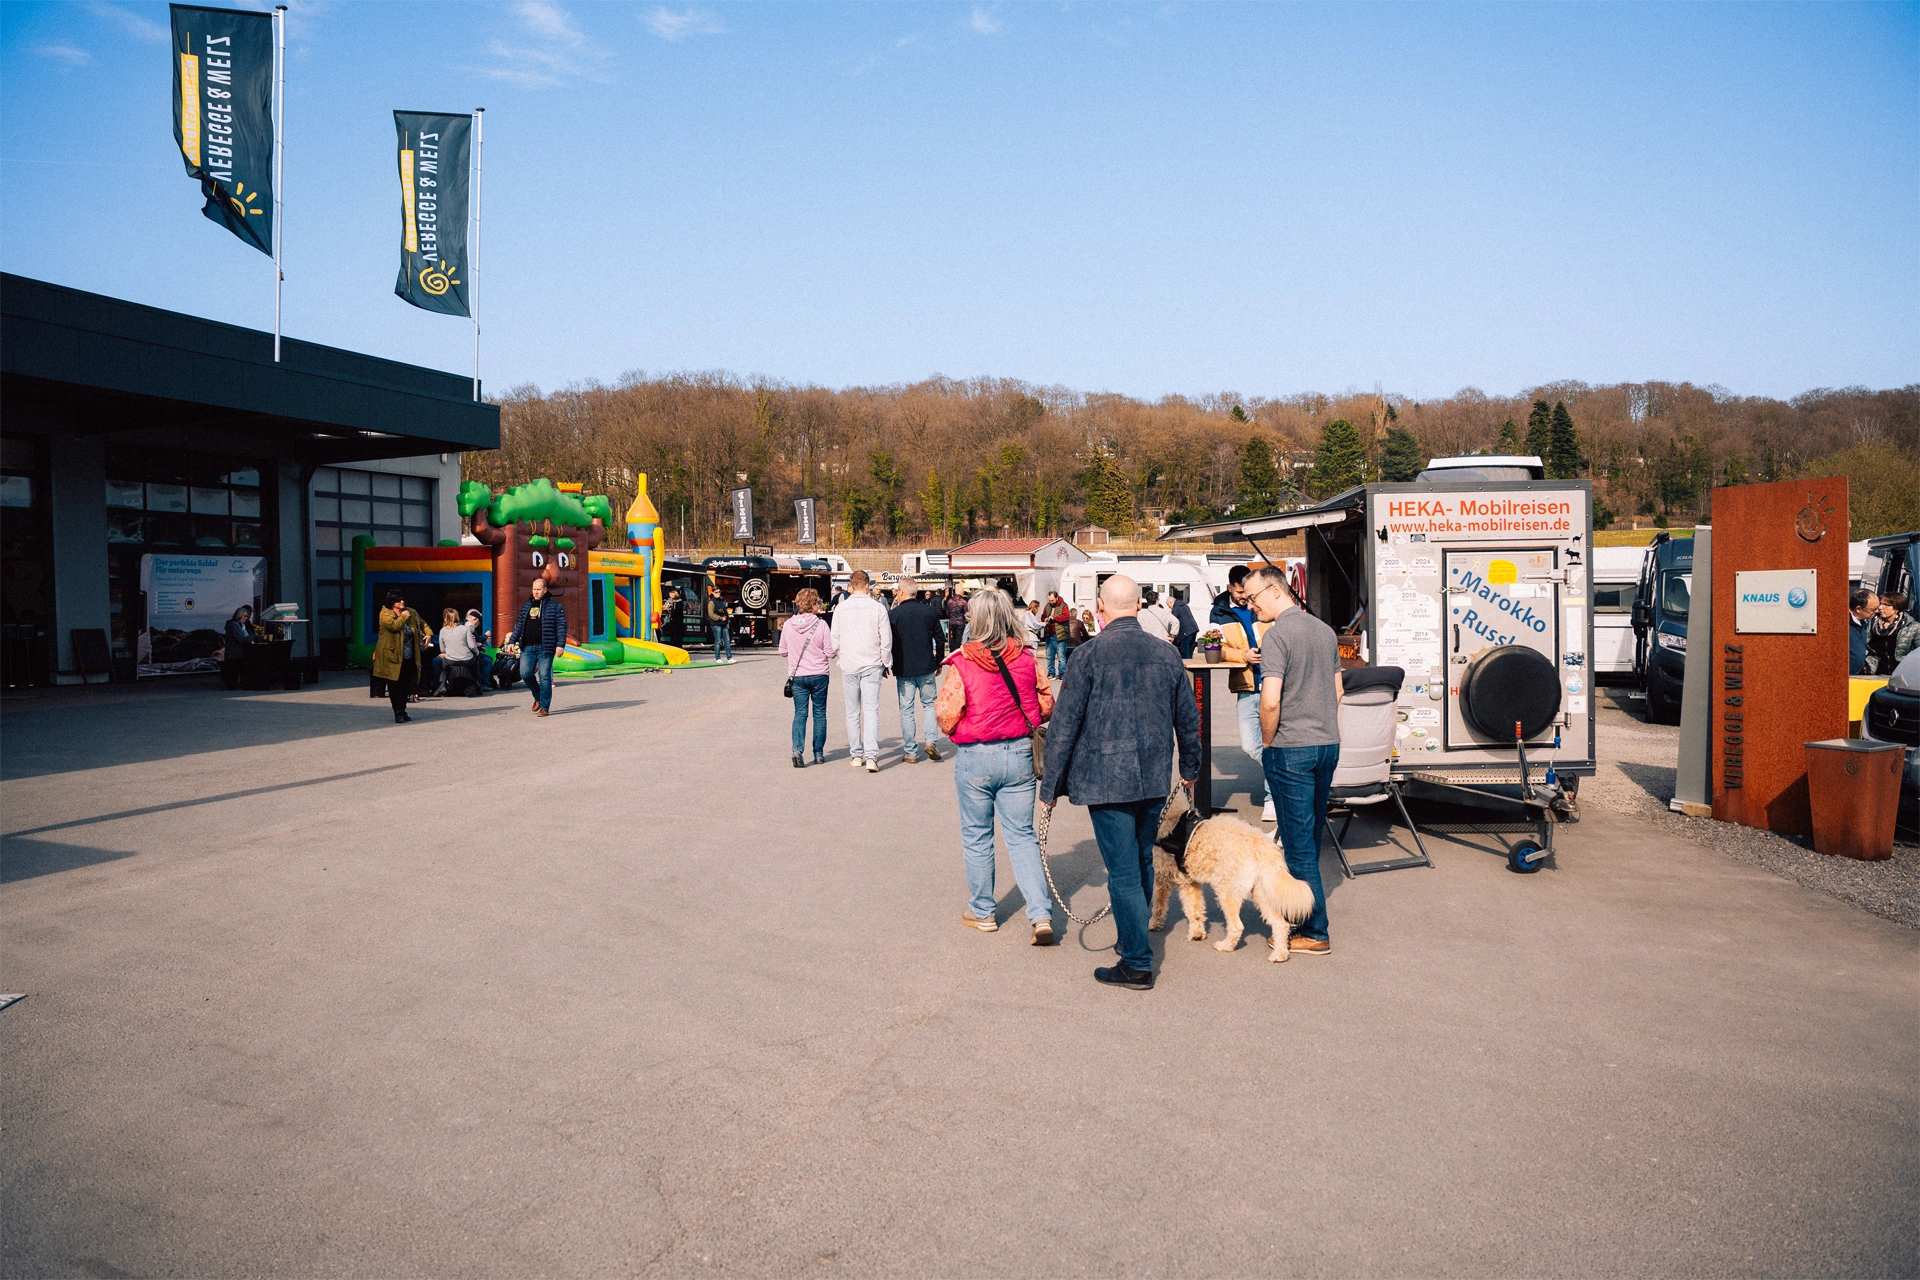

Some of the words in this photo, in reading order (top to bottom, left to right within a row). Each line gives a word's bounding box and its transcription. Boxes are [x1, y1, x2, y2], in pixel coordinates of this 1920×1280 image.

[1389, 501, 1453, 517] HEKA-
[1459, 499, 1570, 516] Mobilreisen
[1390, 517, 1570, 532] www.heka-mobilreisen.de
[156, 558, 168, 566] Der
[169, 559, 197, 568] perfekte
[198, 559, 218, 567] Schlaf
[881, 571, 912, 582] Burger
[1460, 571, 1547, 633] Marokko
[1742, 593, 1781, 603] KNAUS
[1461, 609, 1516, 645] Russl
[1724, 644, 1744, 690] WELZ
[1450, 686, 1459, 696] H
[1724, 695, 1744, 707] &
[1724, 711, 1744, 789] VEREGGE
